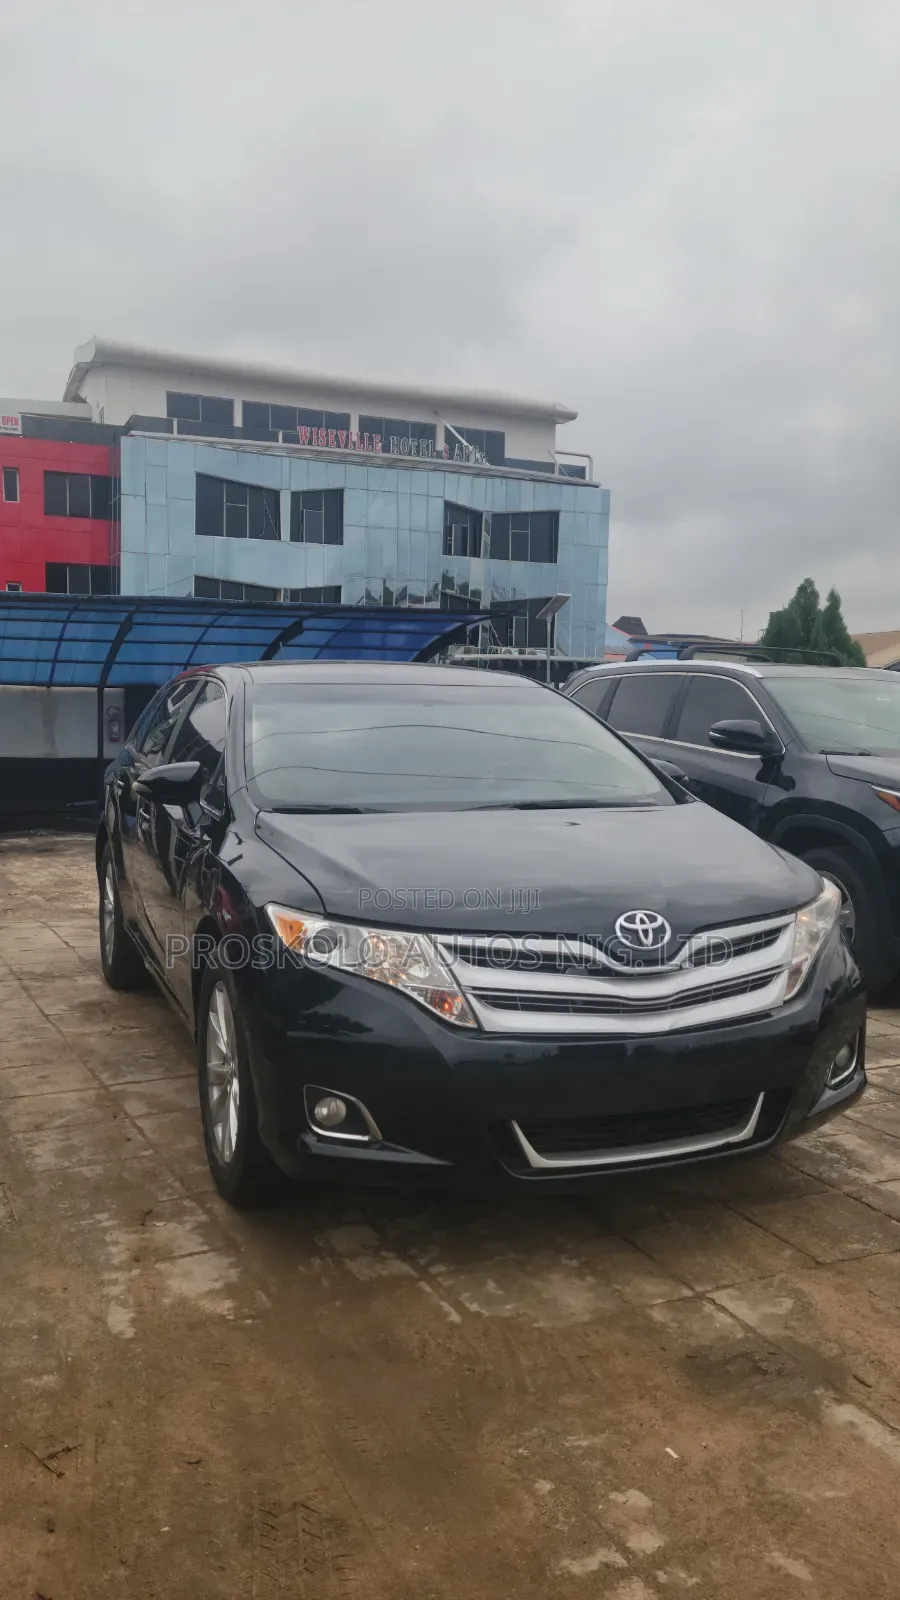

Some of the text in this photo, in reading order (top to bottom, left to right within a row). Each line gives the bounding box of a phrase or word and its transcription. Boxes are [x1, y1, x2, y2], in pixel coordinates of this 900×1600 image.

[2, 415, 19, 427] OPEN
[297, 426, 381, 453] WISEVILLE
[389, 435, 437, 458] HOTEL
